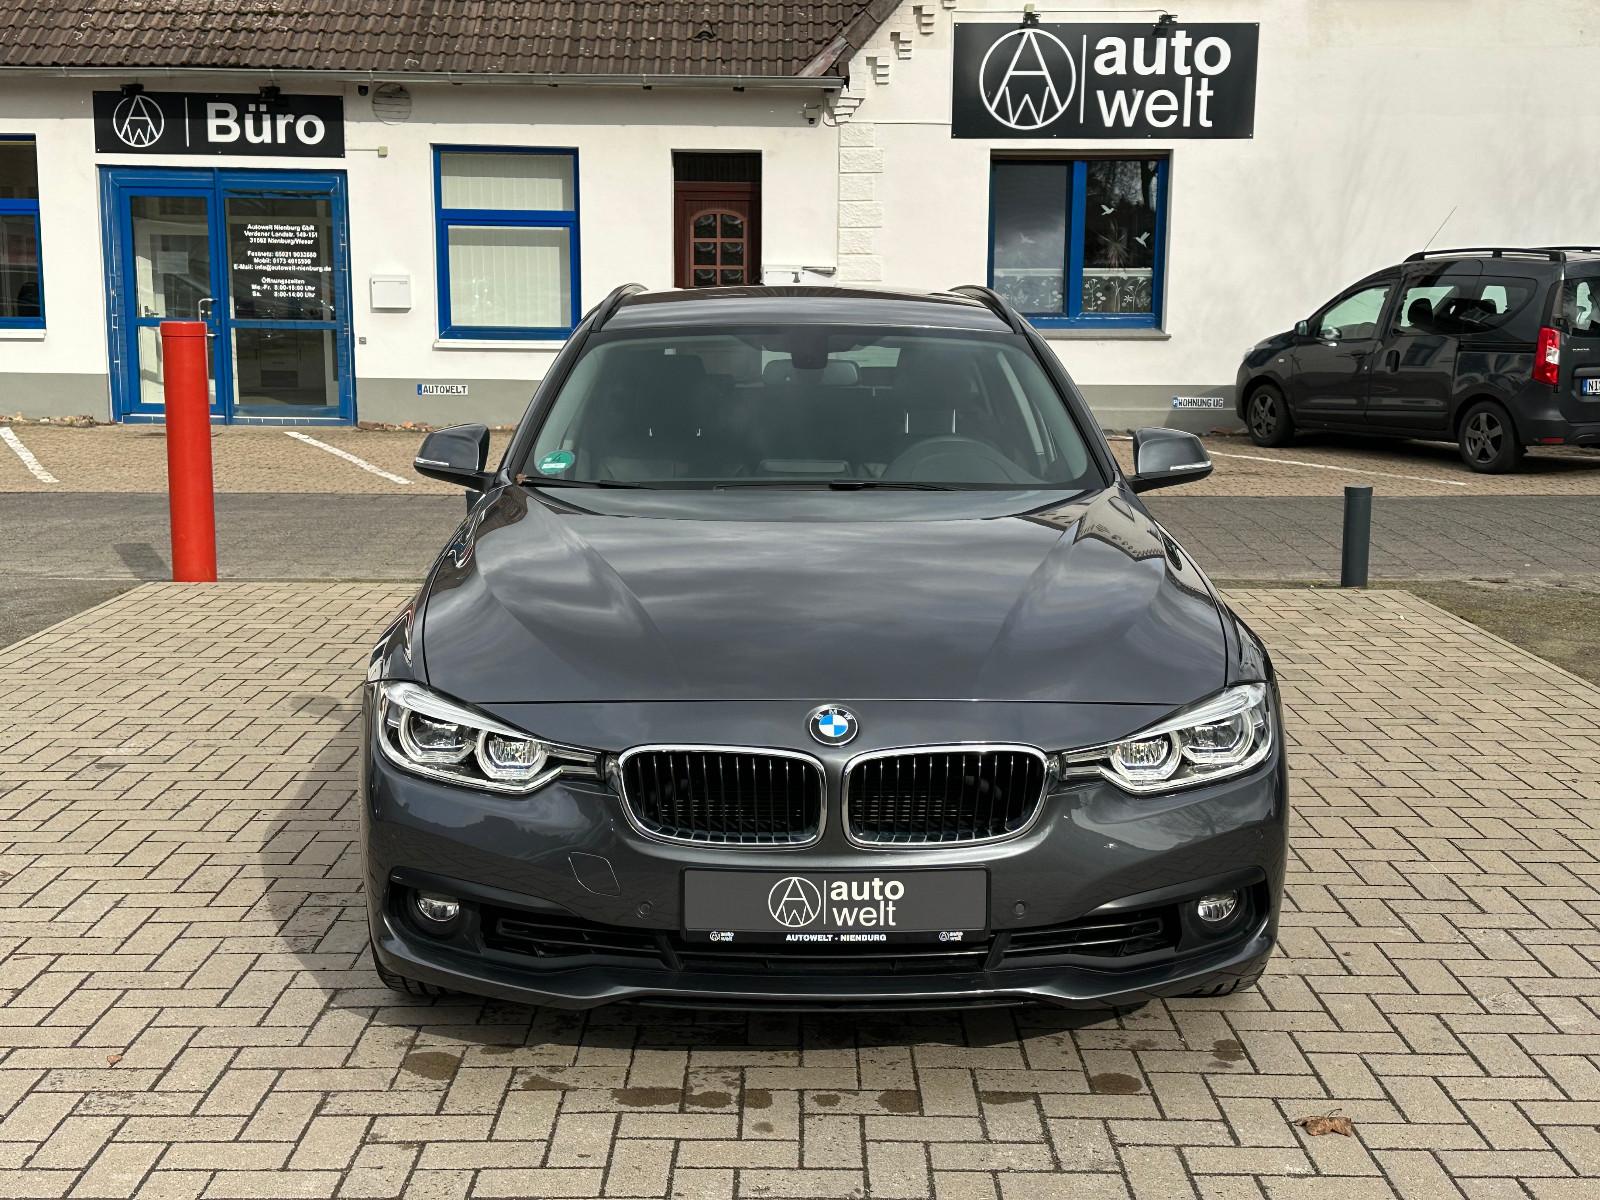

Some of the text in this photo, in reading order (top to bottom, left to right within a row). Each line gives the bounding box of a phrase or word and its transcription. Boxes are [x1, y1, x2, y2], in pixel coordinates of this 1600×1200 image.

[1093, 30, 1232, 76] auto
[1096, 76, 1214, 128] welt
[207, 102, 325, 145] Büro
[273, 224, 300, 232] Nienburg
[423, 385, 467, 394] AUTOWELT
[830, 877, 905, 901] auto
[832, 900, 897, 926] welt
[785, 934, 833, 942] AUTOWELT
